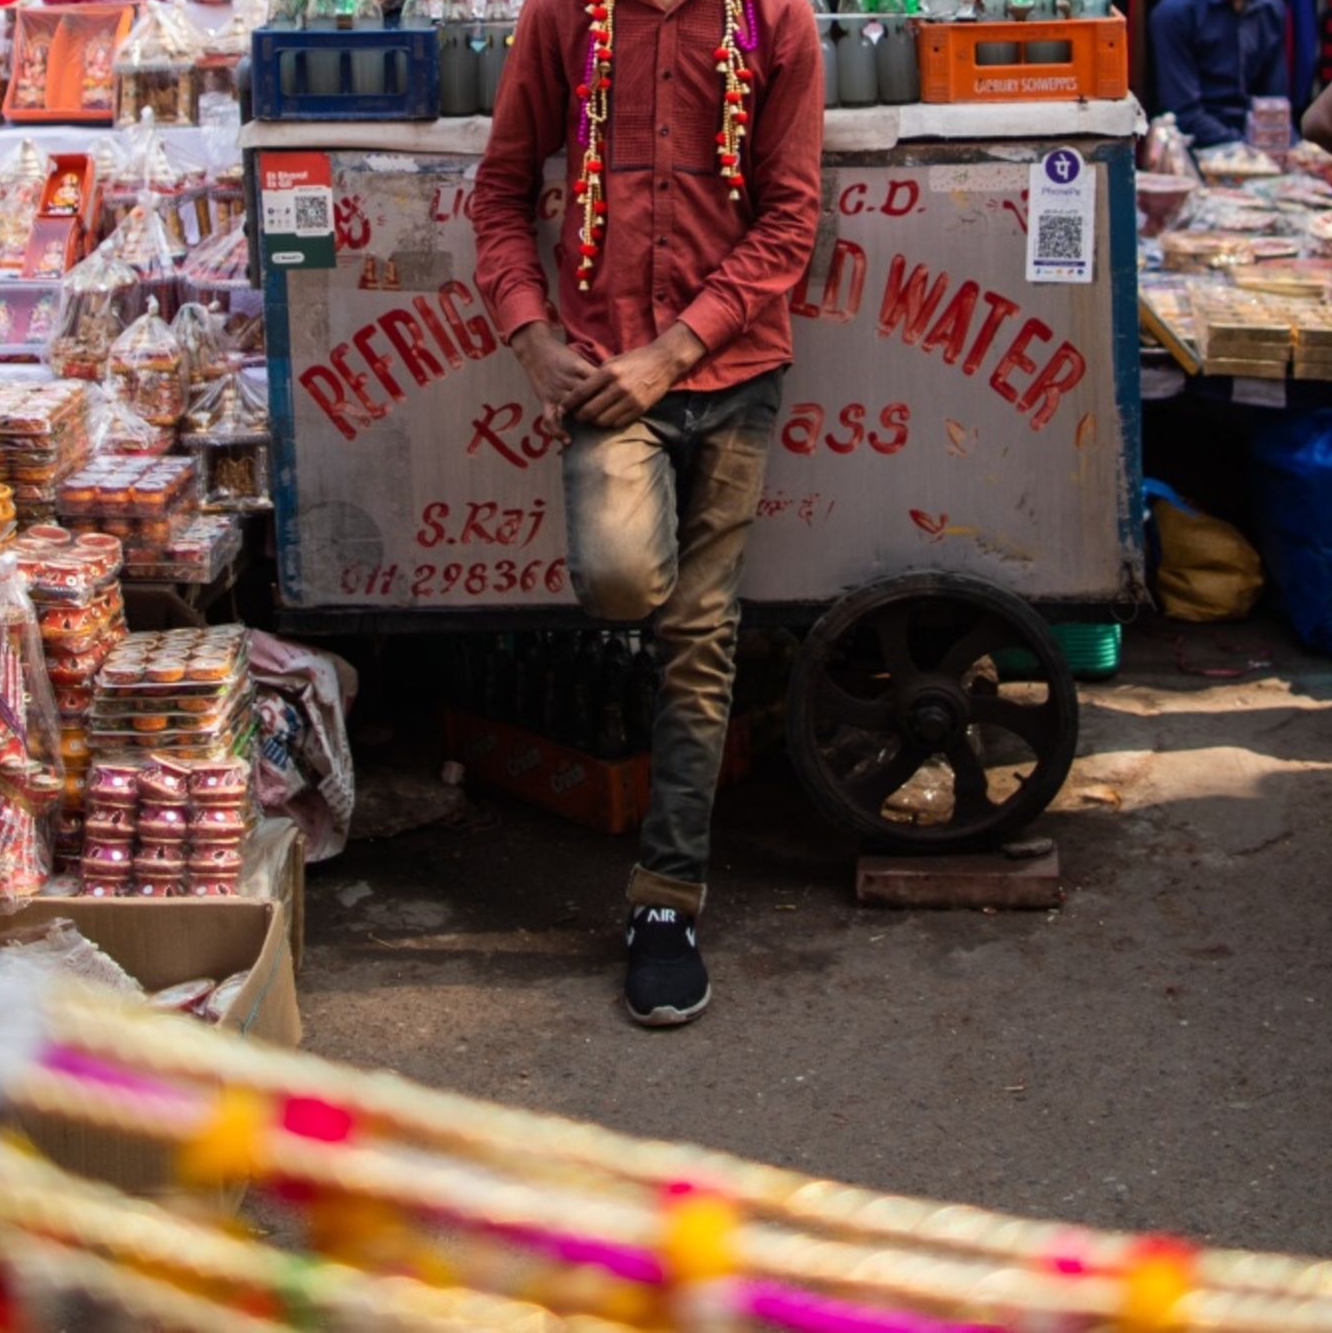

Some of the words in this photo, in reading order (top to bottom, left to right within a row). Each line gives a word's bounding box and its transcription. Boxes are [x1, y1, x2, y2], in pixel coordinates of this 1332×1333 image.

[1021, 76, 1078, 93] SCHWEPPES
[298, 279, 498, 442] REFRIG
[789, 238, 867, 324] LD
[877, 253, 1087, 432] WATER
[781, 402, 911, 456] ass
[416, 498, 547, 549] S.Raj
[410, 557, 566, 597] 298366
[647, 908, 676, 923] AIR
